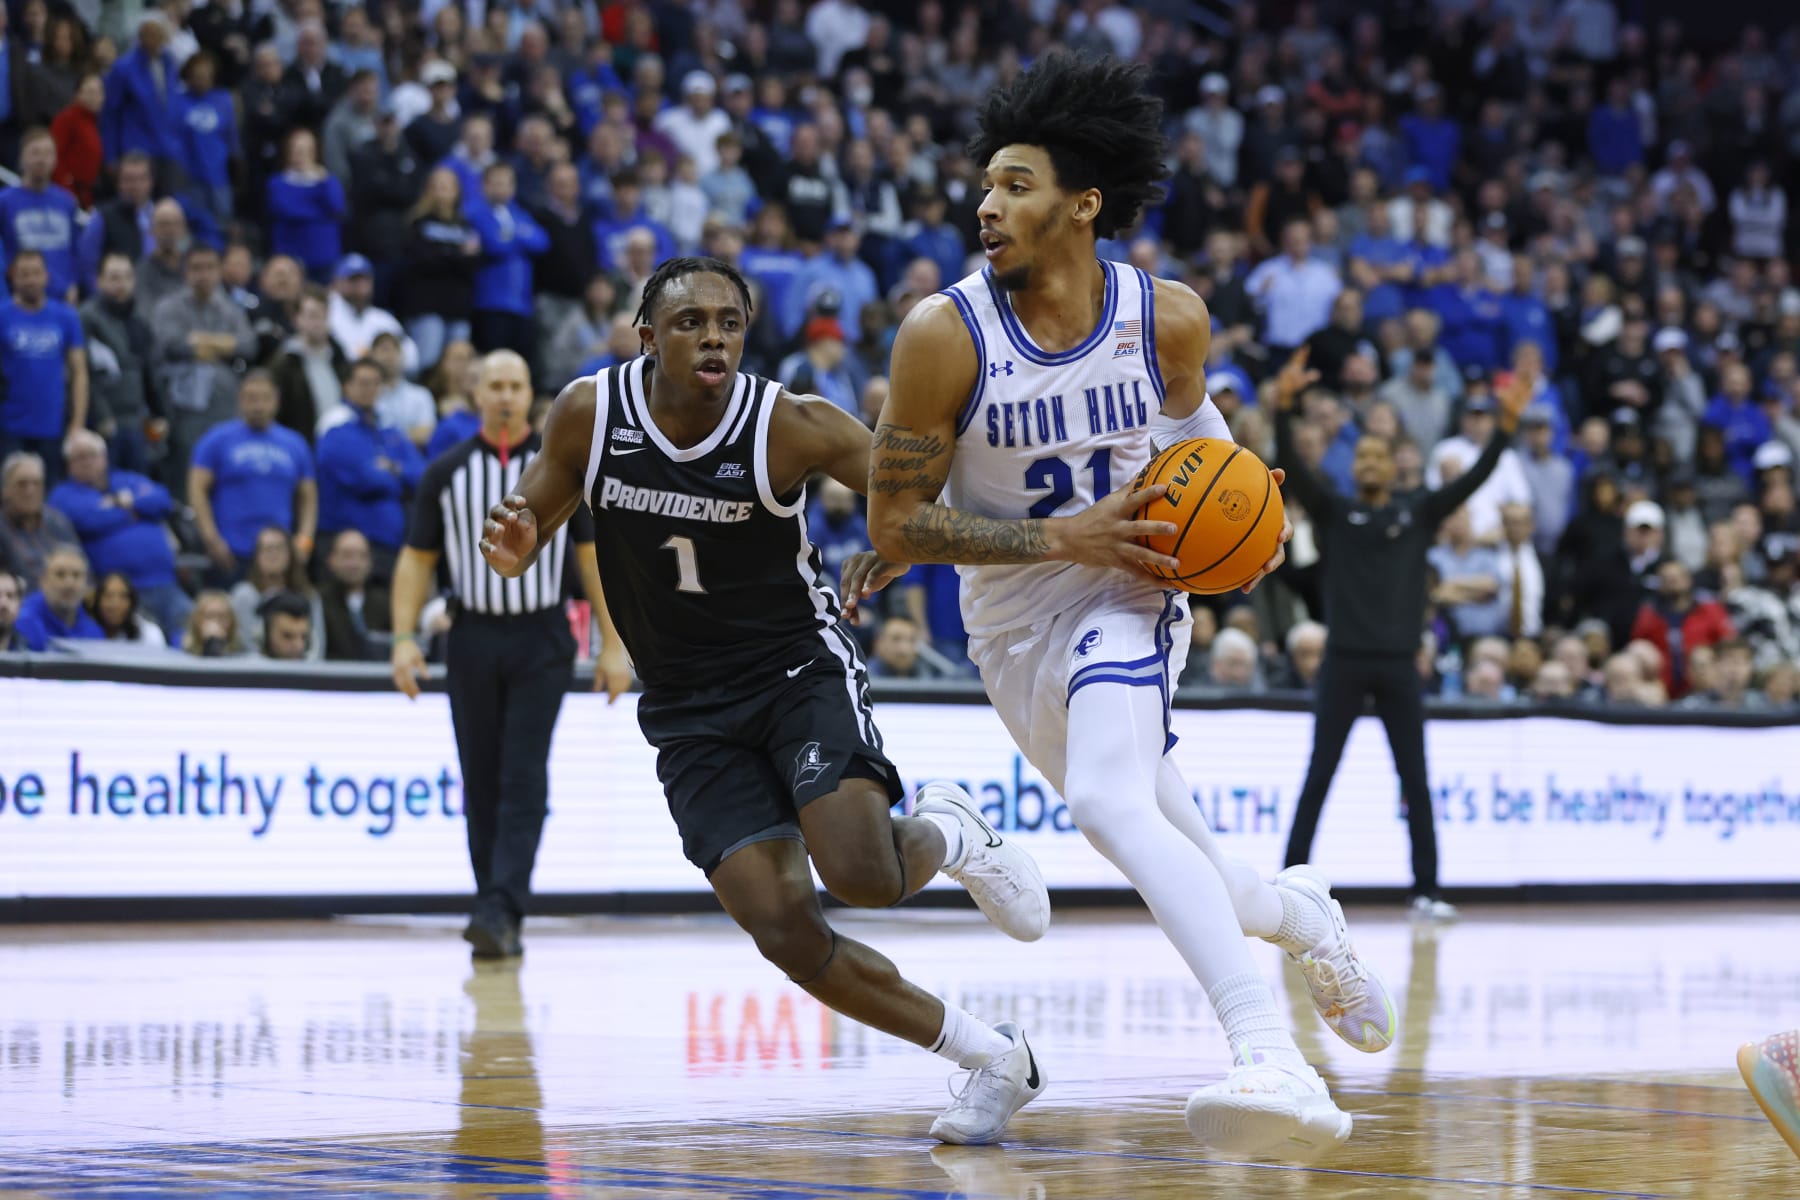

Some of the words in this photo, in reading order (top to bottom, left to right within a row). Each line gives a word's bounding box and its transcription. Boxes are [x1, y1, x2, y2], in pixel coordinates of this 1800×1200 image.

[1117, 342, 1136, 350] BIG
[612, 434, 643, 444] CHANGE
[987, 394, 1069, 448] SETON
[1083, 380, 1148, 436] HALL
[600, 476, 753, 523] PROVIDENCE
[716, 469, 747, 477] EAST
[1023, 448, 1112, 518] 21
[660, 535, 709, 594] 1
[69, 750, 283, 837] healthy
[304, 765, 467, 837] toget
[1493, 773, 1532, 822] be
[1546, 773, 1672, 840] healthy
